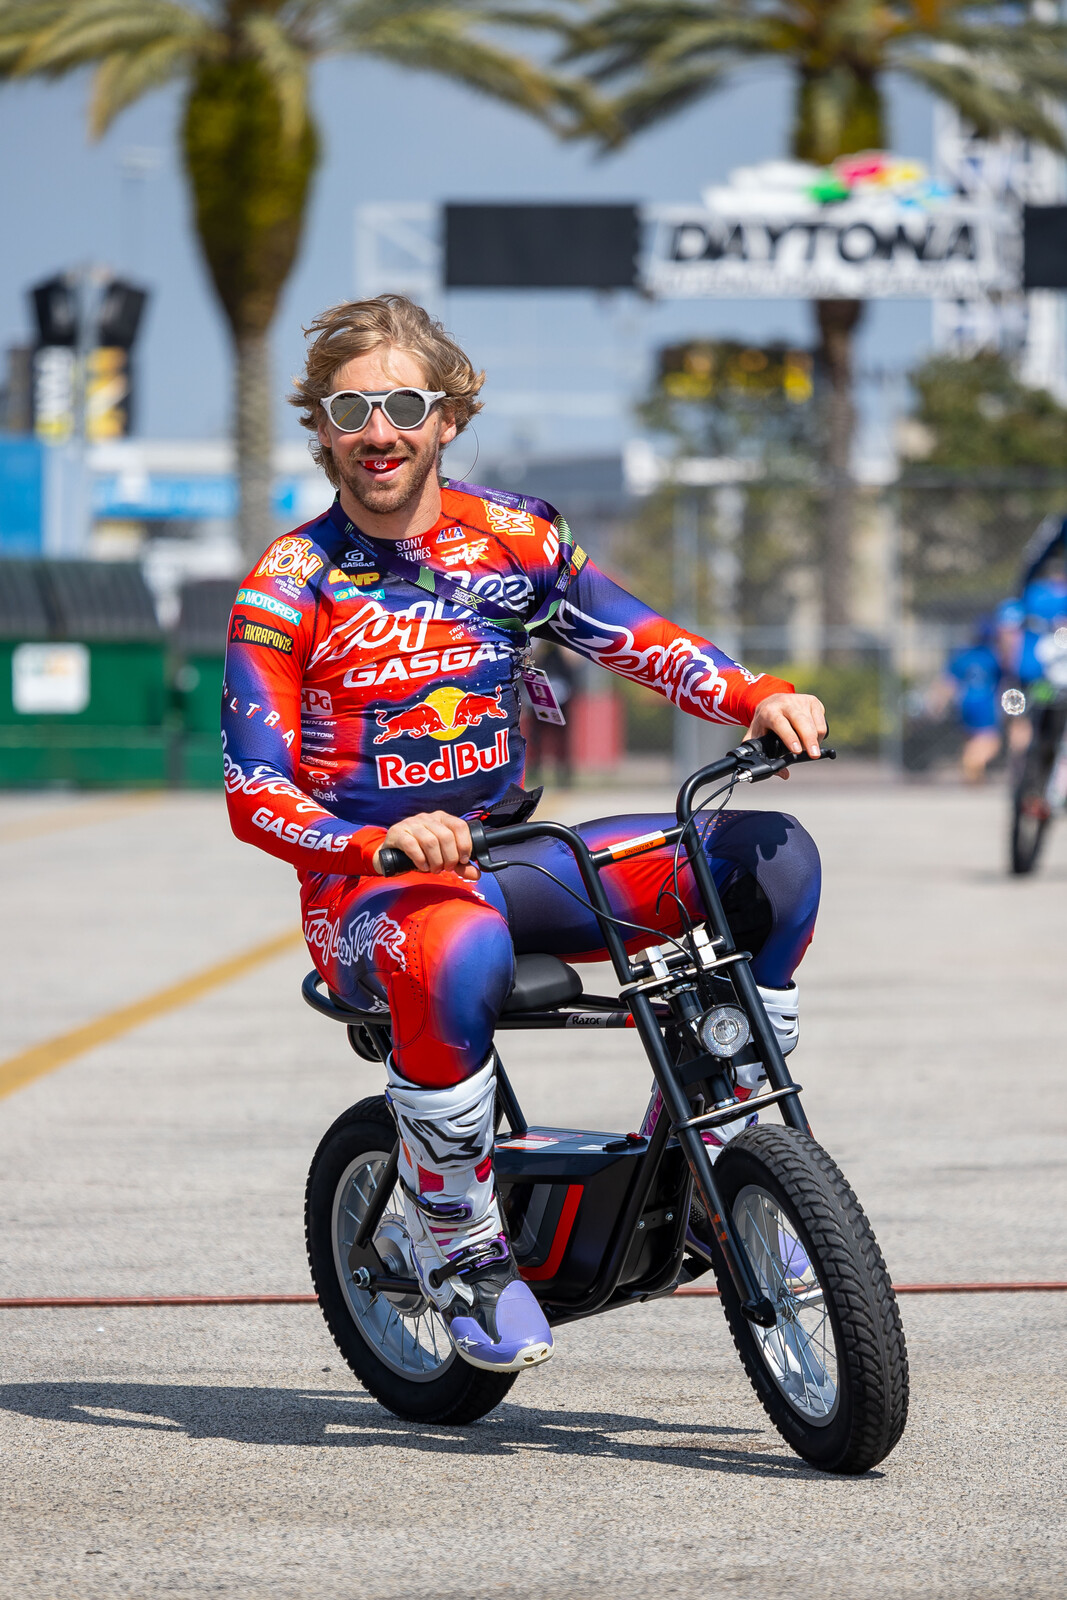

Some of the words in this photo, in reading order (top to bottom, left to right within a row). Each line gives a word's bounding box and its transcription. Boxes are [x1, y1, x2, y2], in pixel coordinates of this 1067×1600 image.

[670, 222, 975, 263] DAYTONA
[437, 527, 465, 542] AMA
[395, 536, 424, 552] SONY
[397, 547, 431, 562] TURES
[341, 561, 375, 569] GASGAS
[245, 591, 300, 624] MOTOREX
[342, 641, 516, 688] GASGAS
[375, 744, 454, 790] Red
[454, 727, 511, 780] Bull
[307, 777, 336, 786] OAKLEY
[252, 807, 353, 853] GASGAS
[572, 1015, 602, 1025] Razor
